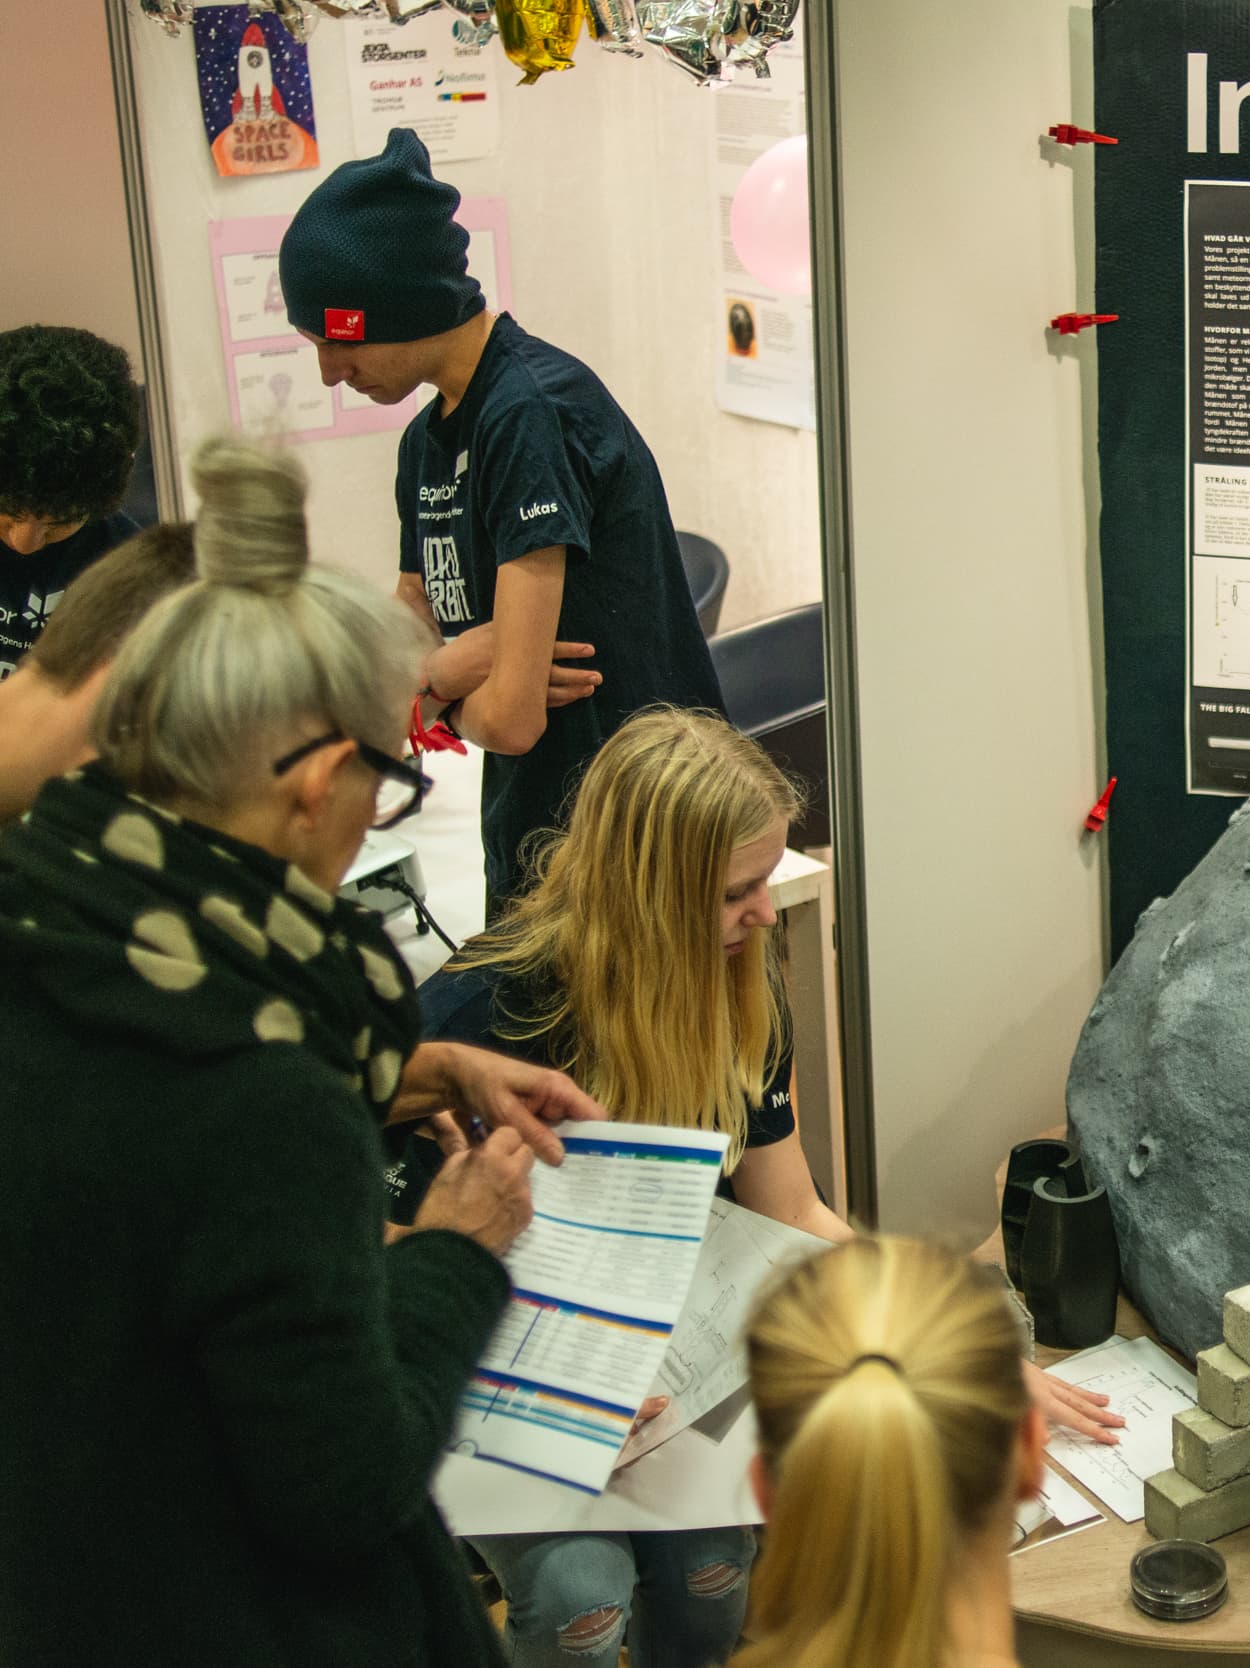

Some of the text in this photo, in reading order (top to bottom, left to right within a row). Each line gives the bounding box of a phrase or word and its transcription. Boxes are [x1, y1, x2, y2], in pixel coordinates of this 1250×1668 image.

[409, 77, 423, 88] AS
[233, 121, 291, 144] SPACE
[232, 143, 290, 163] GIRLS
[1227, 234, 1243, 243] GÅR
[1204, 326, 1240, 334] HVORFOR
[1204, 476, 1247, 486] STRÅLING
[519, 502, 559, 521] Lukas
[1200, 703, 1216, 712] THE
[1218, 704, 1233, 713] BIG
